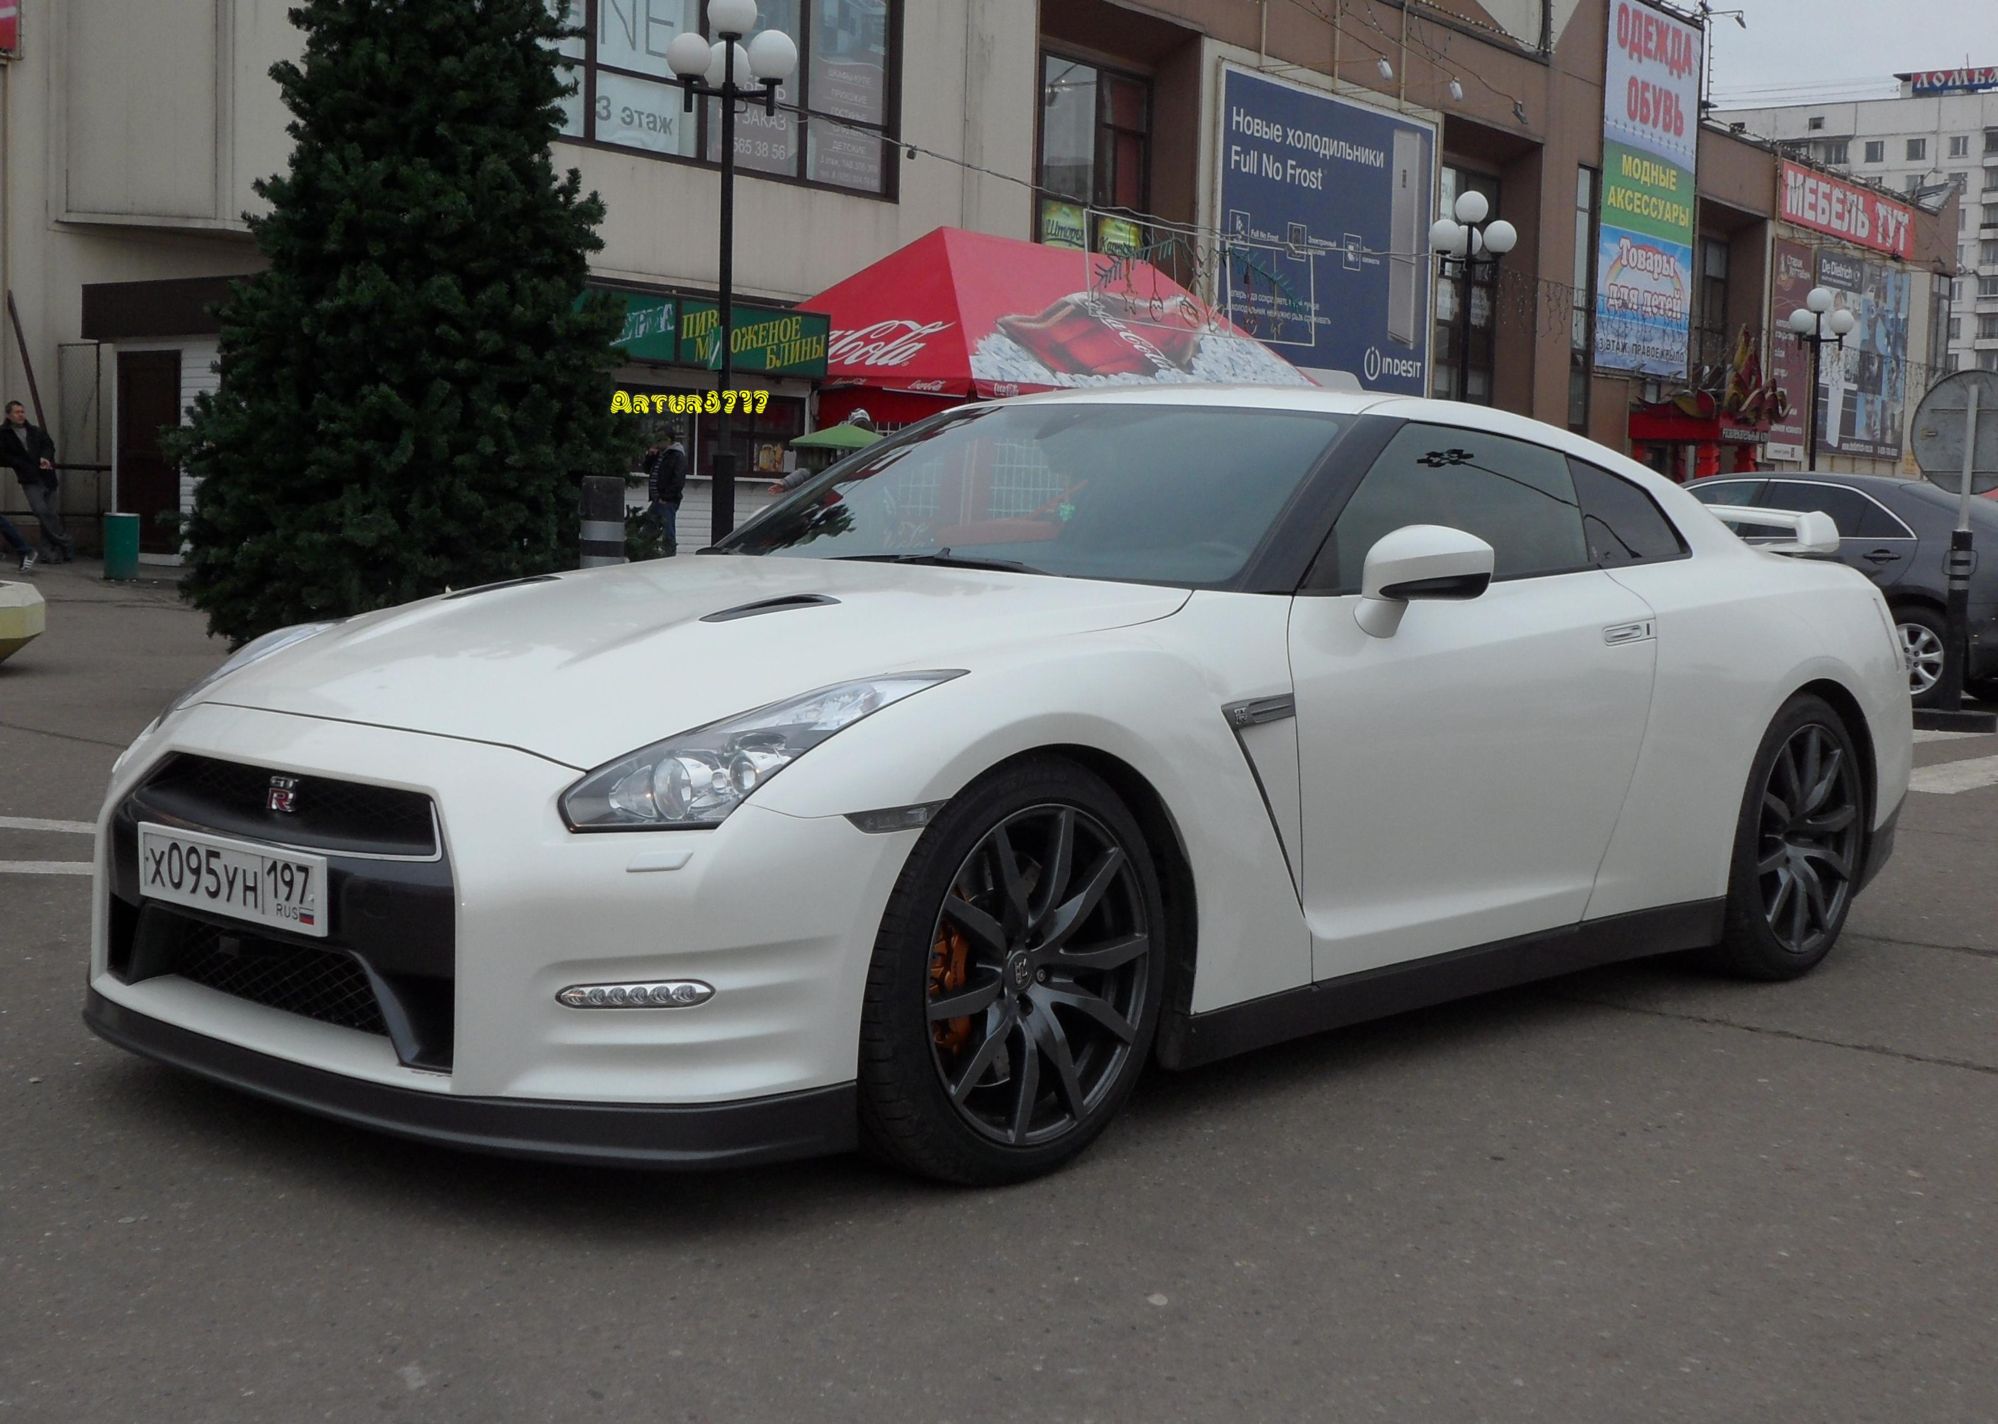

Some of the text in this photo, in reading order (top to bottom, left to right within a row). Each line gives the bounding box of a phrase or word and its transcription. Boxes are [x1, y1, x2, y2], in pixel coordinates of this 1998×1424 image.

[1617, 2, 1693, 80] ОДЕЖДА
[620, 104, 673, 136] этаж
[742, 109, 786, 130] ЗАКАЗ
[1626, 75, 1684, 137] ОБУВЬ
[755, 141, 768, 157] 38
[1232, 106, 1384, 168] Новые холодильники
[1231, 145, 1323, 190] Full No Frost
[1621, 154, 1677, 191] МОДНЫЕ
[1607, 186, 1689, 227] АКСЕССУАРЫ
[1786, 170, 1910, 251] МЕБЕЛЬ ТУТ
[1619, 236, 1676, 281] Товары
[1822, 259, 1831, 274] De
[1607, 283, 1682, 319] для детей
[681, 309, 719, 340] ПИВ
[694, 315, 803, 363] МОЖЕНОЕ
[765, 334, 826, 370] БЛИНЫ
[1631, 343, 1660, 359] ПРАВОЕ
[266, 861, 310, 904] 197
[276, 903, 299, 920] RUS
